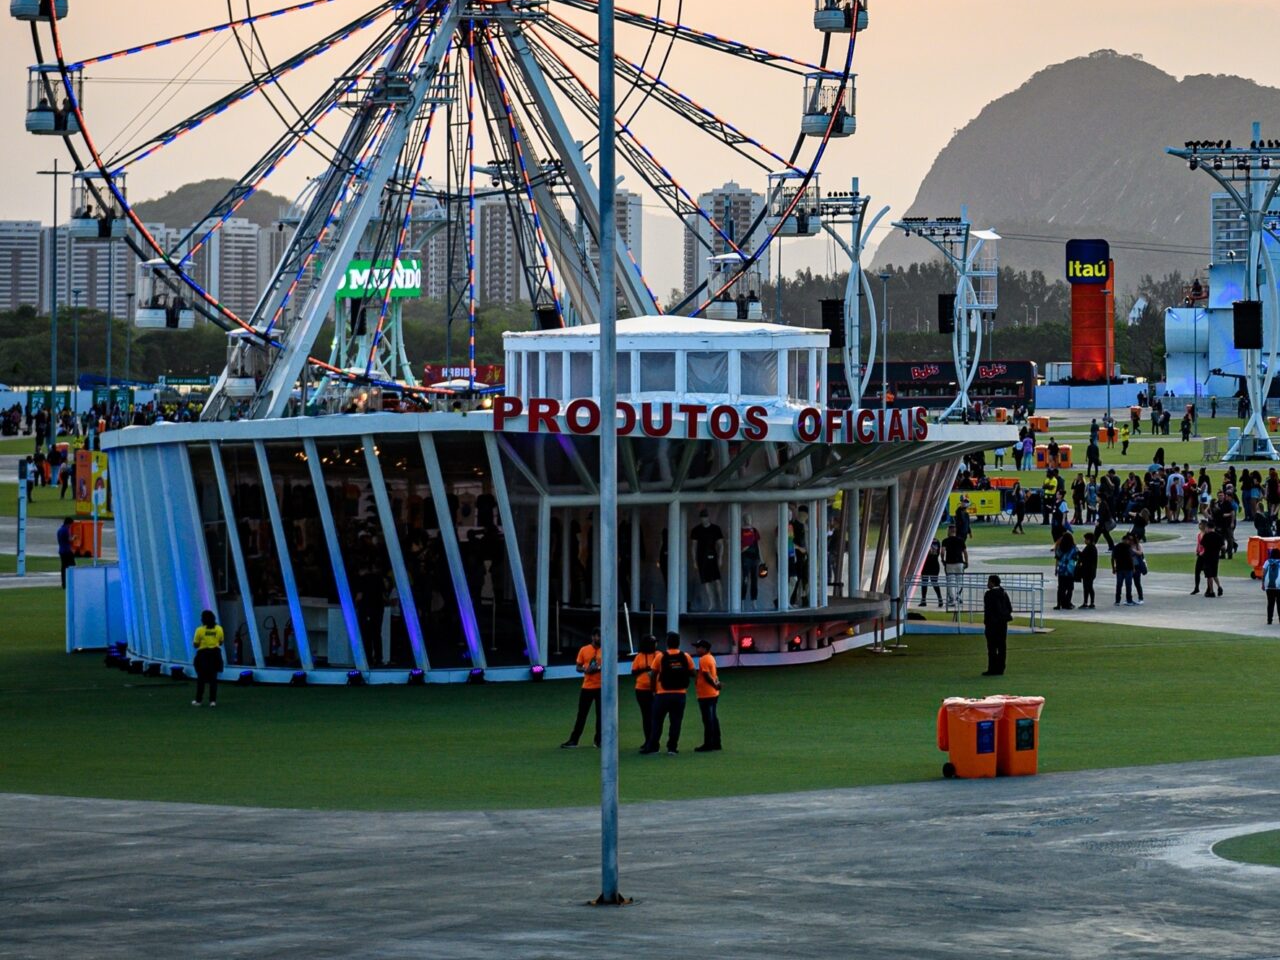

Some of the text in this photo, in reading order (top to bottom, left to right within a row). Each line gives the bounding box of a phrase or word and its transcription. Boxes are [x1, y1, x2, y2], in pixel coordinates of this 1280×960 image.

[1069, 260, 1106, 277] Itaú
[911, 364, 940, 380] Bob's
[979, 363, 1008, 379] Bob's
[493, 396, 929, 444] PRODUTOS OFICIAIS
